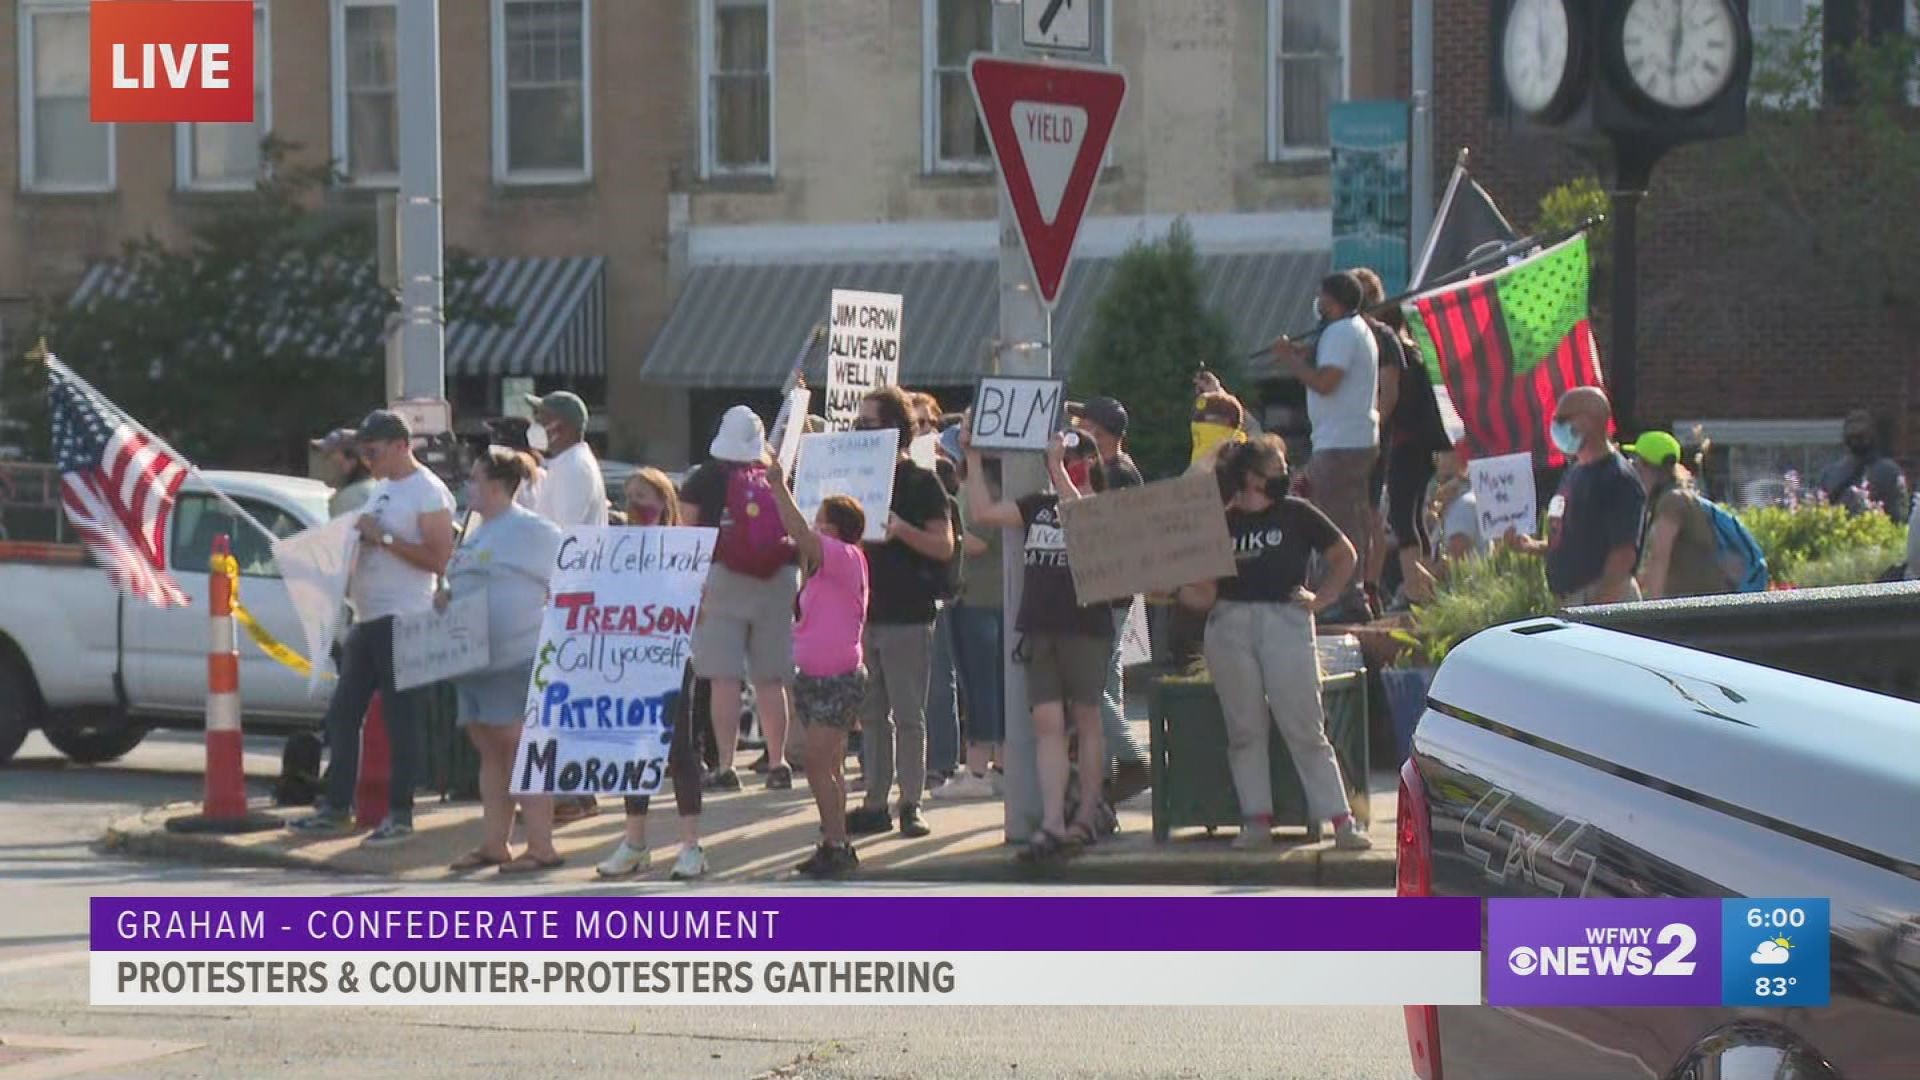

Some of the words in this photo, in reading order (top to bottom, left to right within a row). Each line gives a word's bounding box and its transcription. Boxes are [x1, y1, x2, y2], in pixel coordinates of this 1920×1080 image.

[1027, 112, 1073, 144] YIELD
[833, 304, 856, 326] JIM
[860, 306, 897, 330] CROW
[831, 335, 868, 358] ALIVE
[870, 338, 897, 361] AND
[836, 361, 870, 386] WELL
[875, 366, 888, 386] IN
[977, 387, 1058, 441] BLM
[555, 591, 696, 635] TREASON
[557, 633, 604, 672] Call
[604, 637, 689, 683] yourself
[522, 739, 663, 792] MORONS
